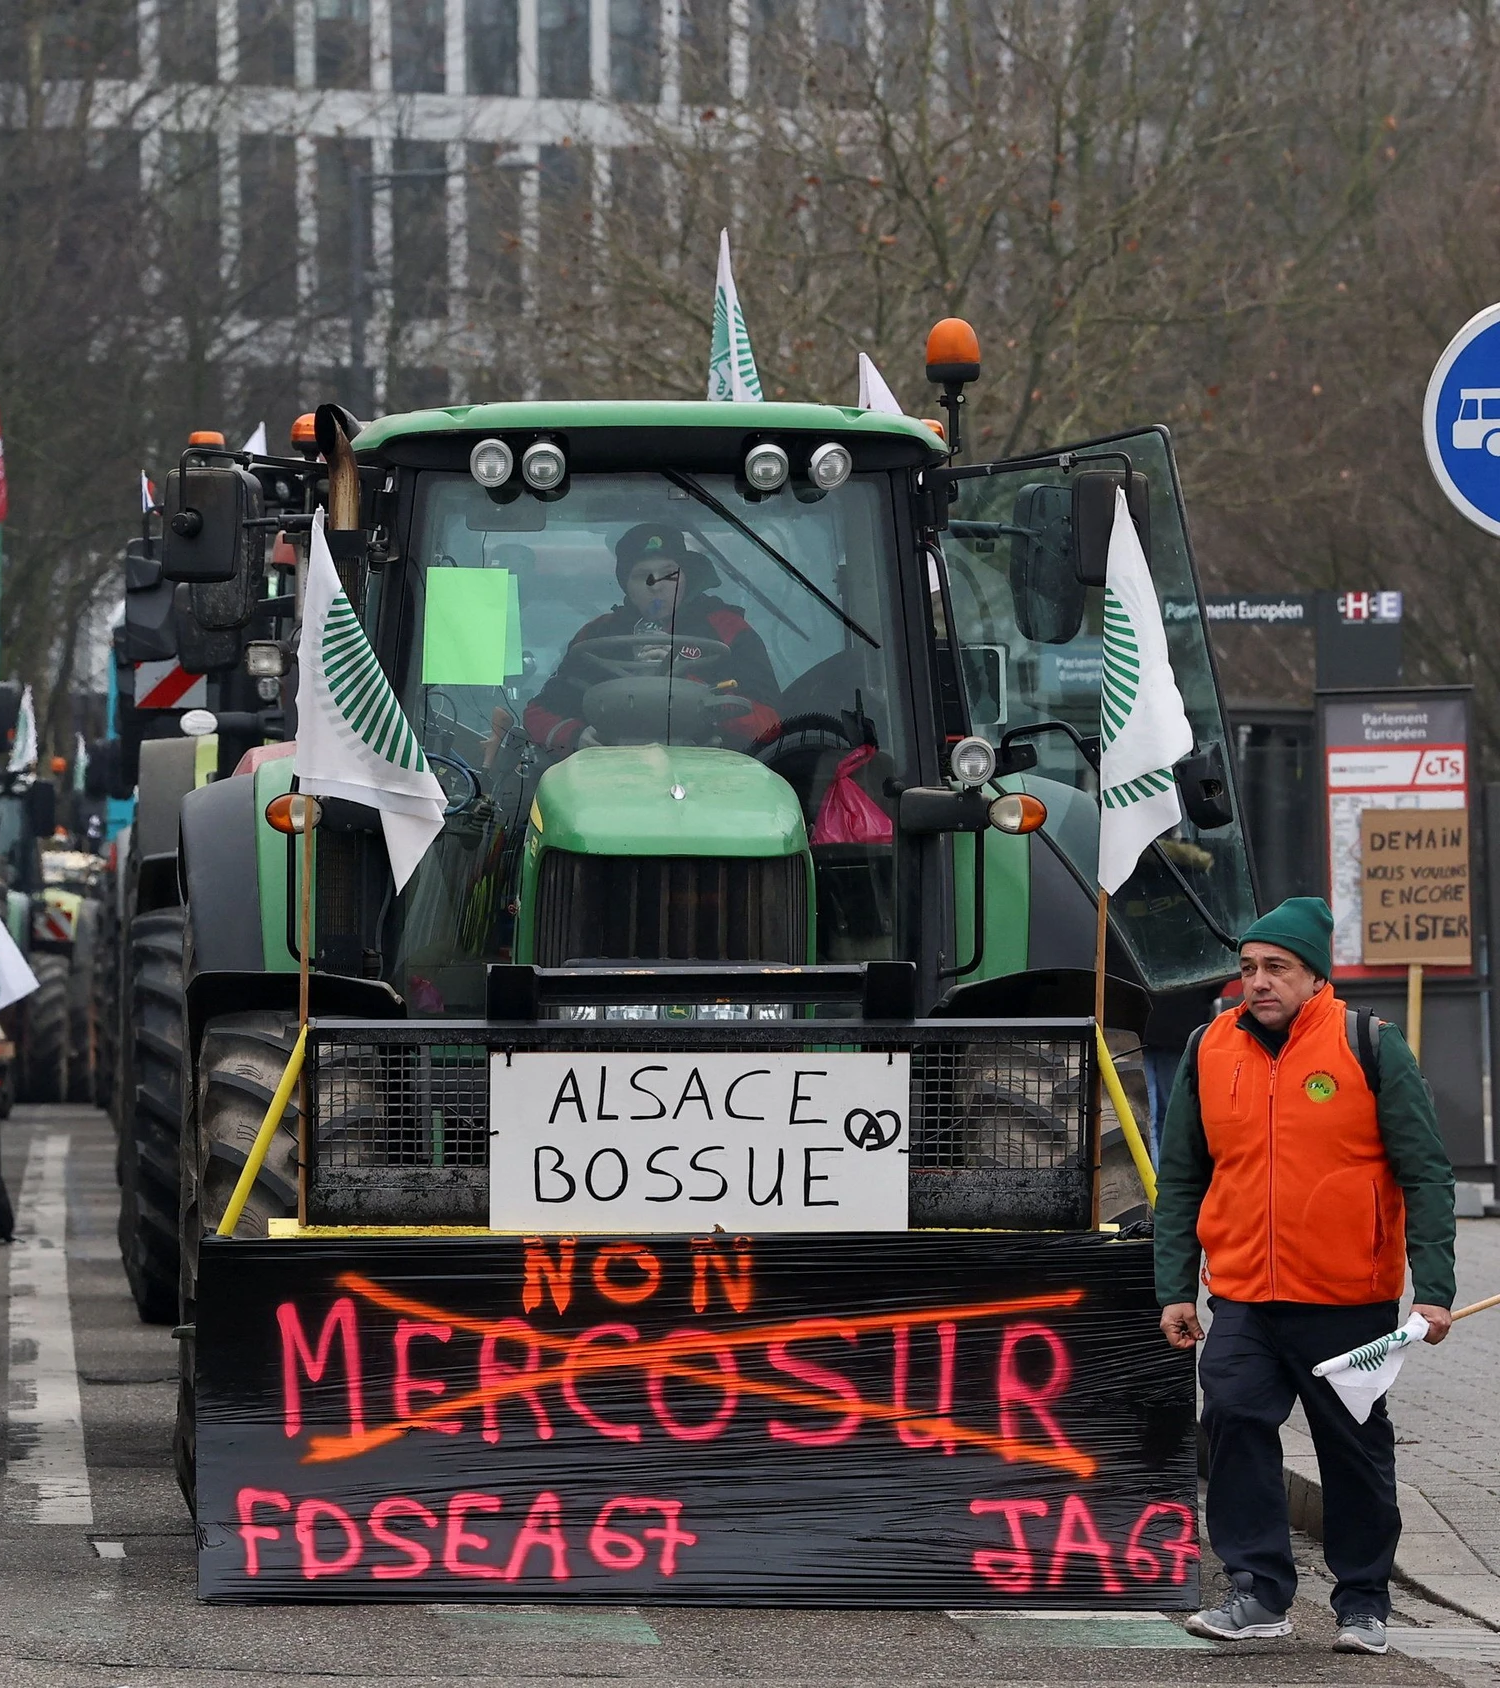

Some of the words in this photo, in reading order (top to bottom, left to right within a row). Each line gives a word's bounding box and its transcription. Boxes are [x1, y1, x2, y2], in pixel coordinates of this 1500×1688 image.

[1239, 600, 1304, 623] Européen
[1362, 712, 1429, 725] Parlement
[1364, 726, 1428, 741] Européen
[1366, 865, 1406, 881] NOUS
[1380, 884, 1466, 908] ENCORE
[548, 1065, 829, 1125] ALSACE
[534, 1145, 844, 1207] BOSSUE
[521, 1236, 756, 1315] NON
[275, 1296, 1076, 1461] MERCOSUR
